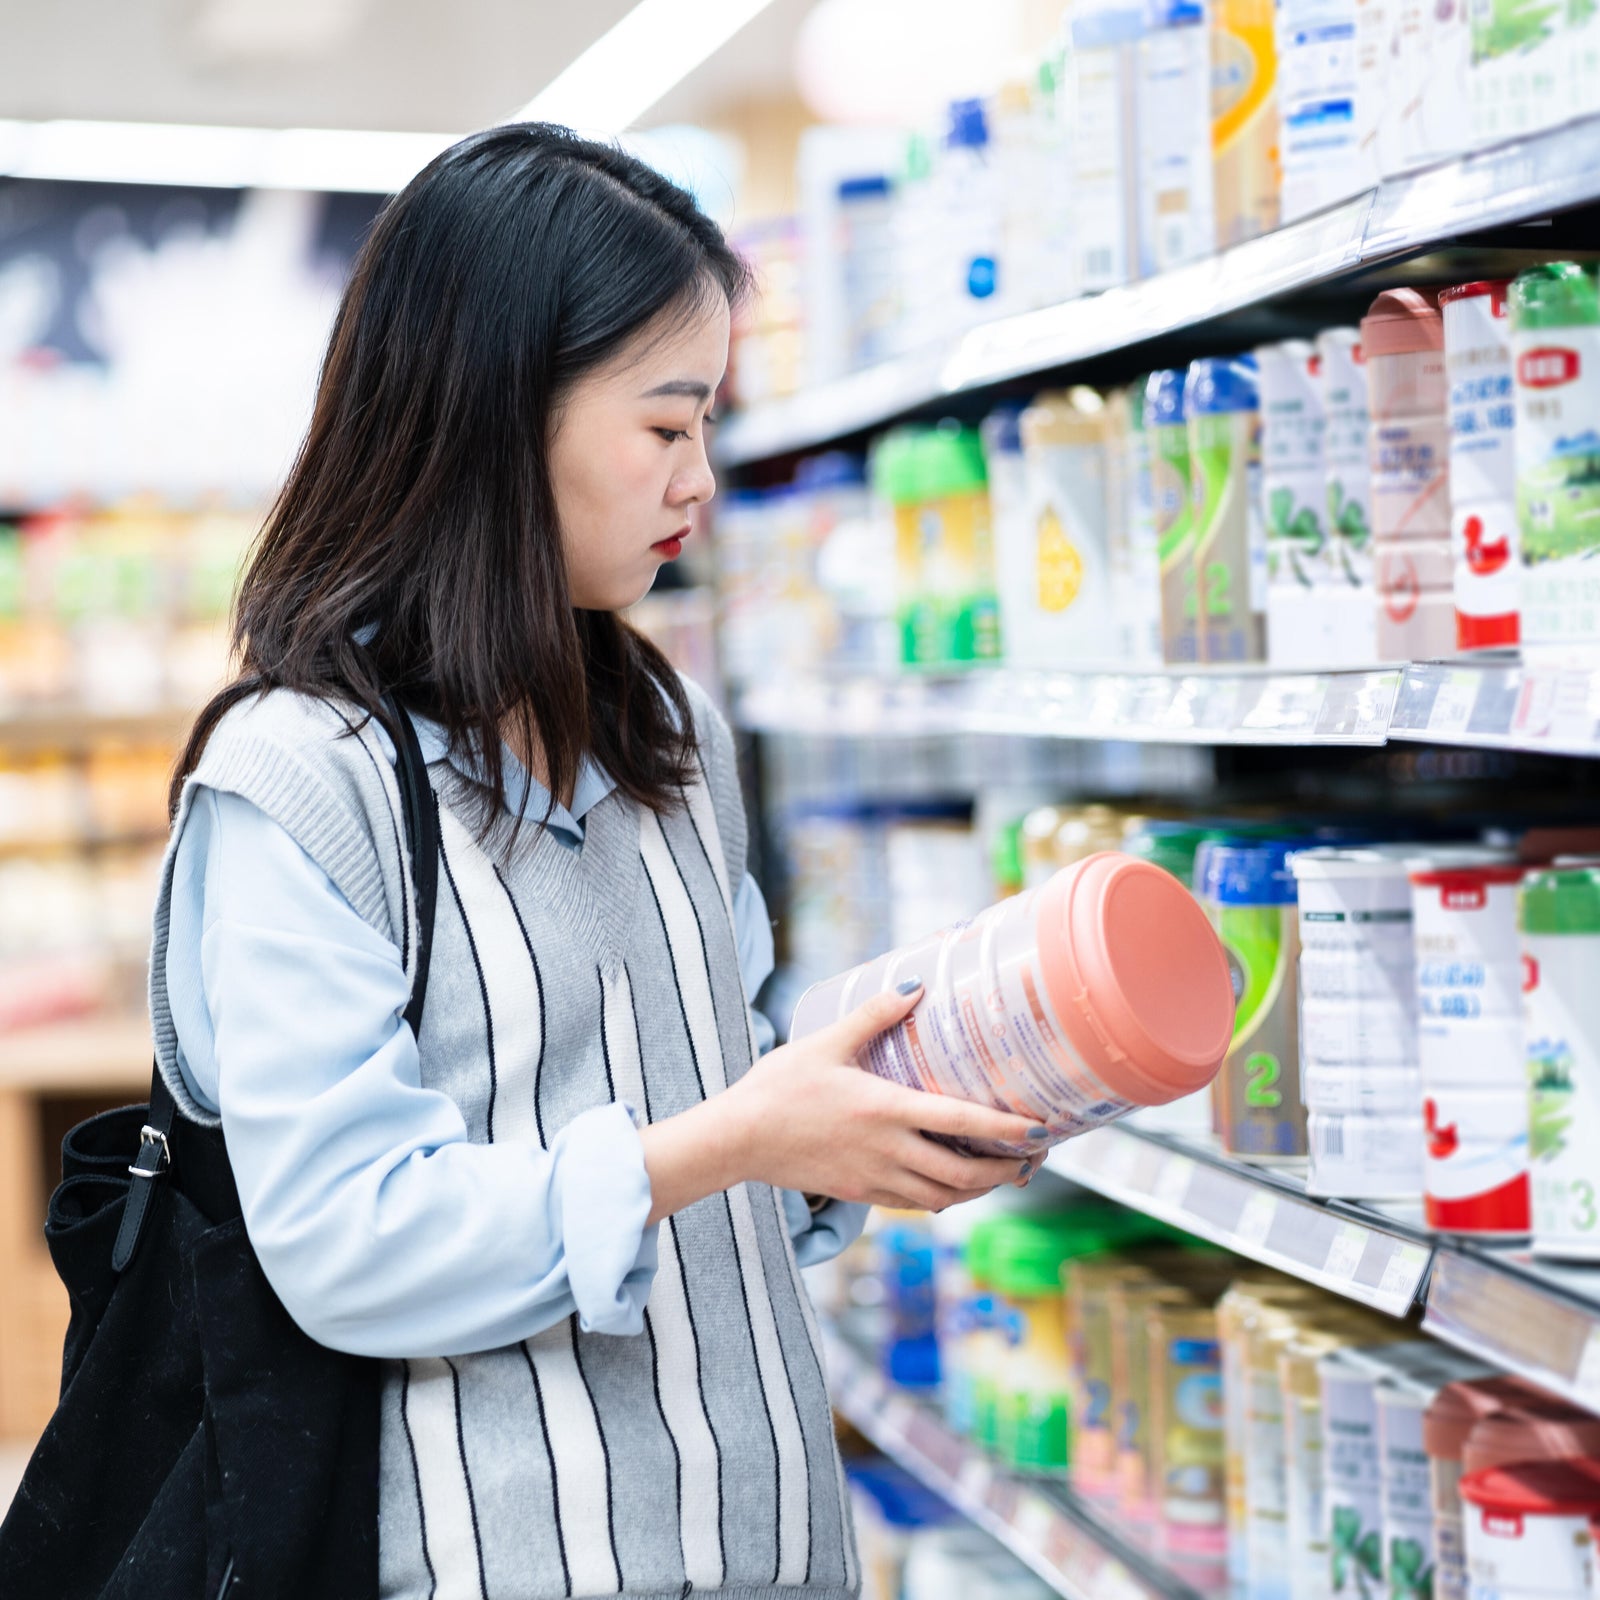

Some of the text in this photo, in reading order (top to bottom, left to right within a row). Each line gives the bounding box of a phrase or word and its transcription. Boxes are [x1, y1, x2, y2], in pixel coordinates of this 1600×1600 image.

[1204, 562, 1232, 615] 2
[1245, 1052, 1281, 1107] 2
[1571, 1178, 1597, 1231] 3
